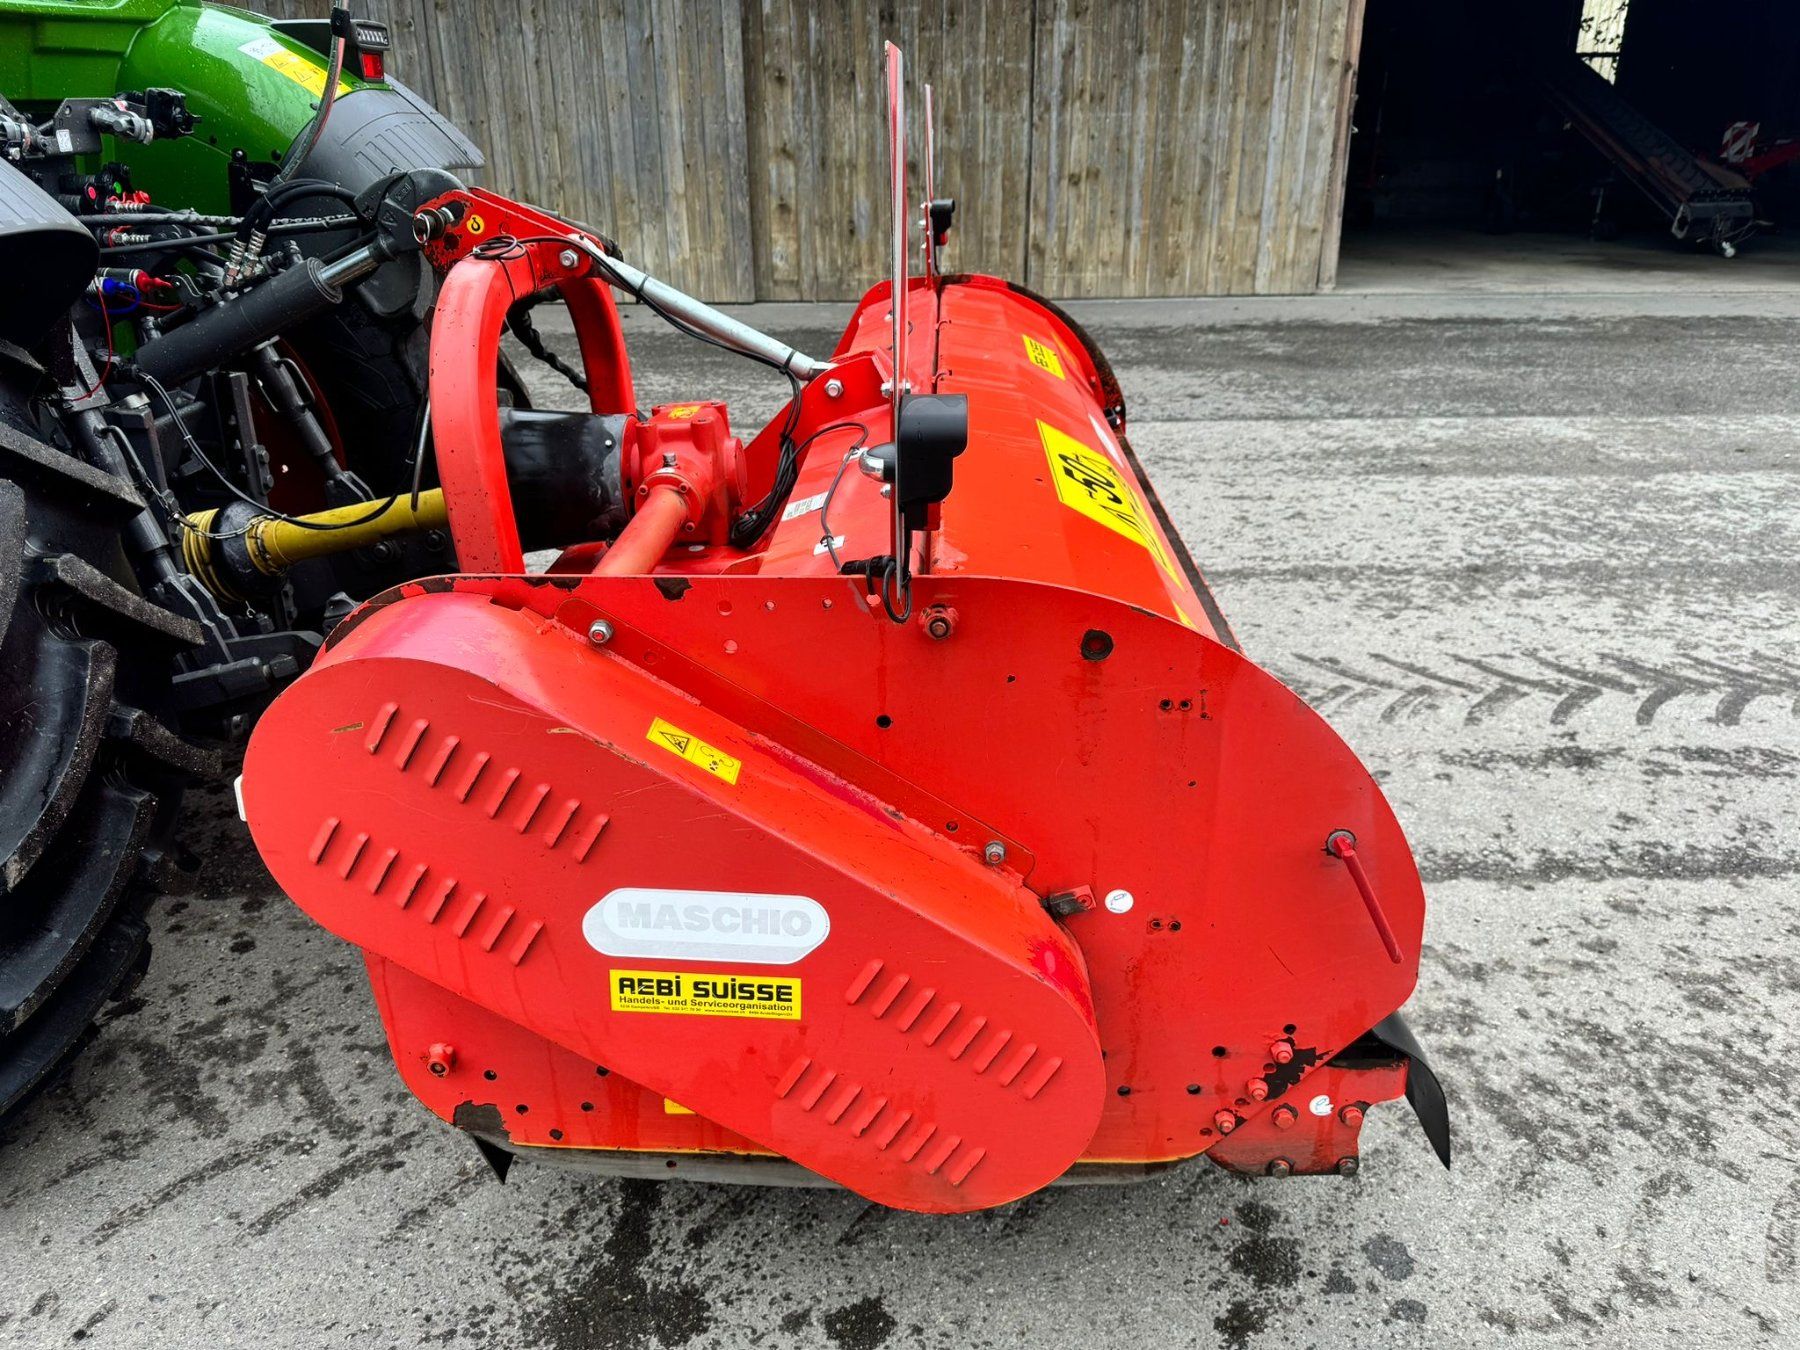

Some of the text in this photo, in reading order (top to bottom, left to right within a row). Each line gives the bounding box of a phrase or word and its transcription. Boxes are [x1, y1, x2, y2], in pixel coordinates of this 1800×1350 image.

[1058, 453, 1123, 505] 50
[617, 902, 812, 937] MASCHIO
[619, 996, 664, 1005] Handels-
[690, 999, 793, 1011] Serviceorganisation
